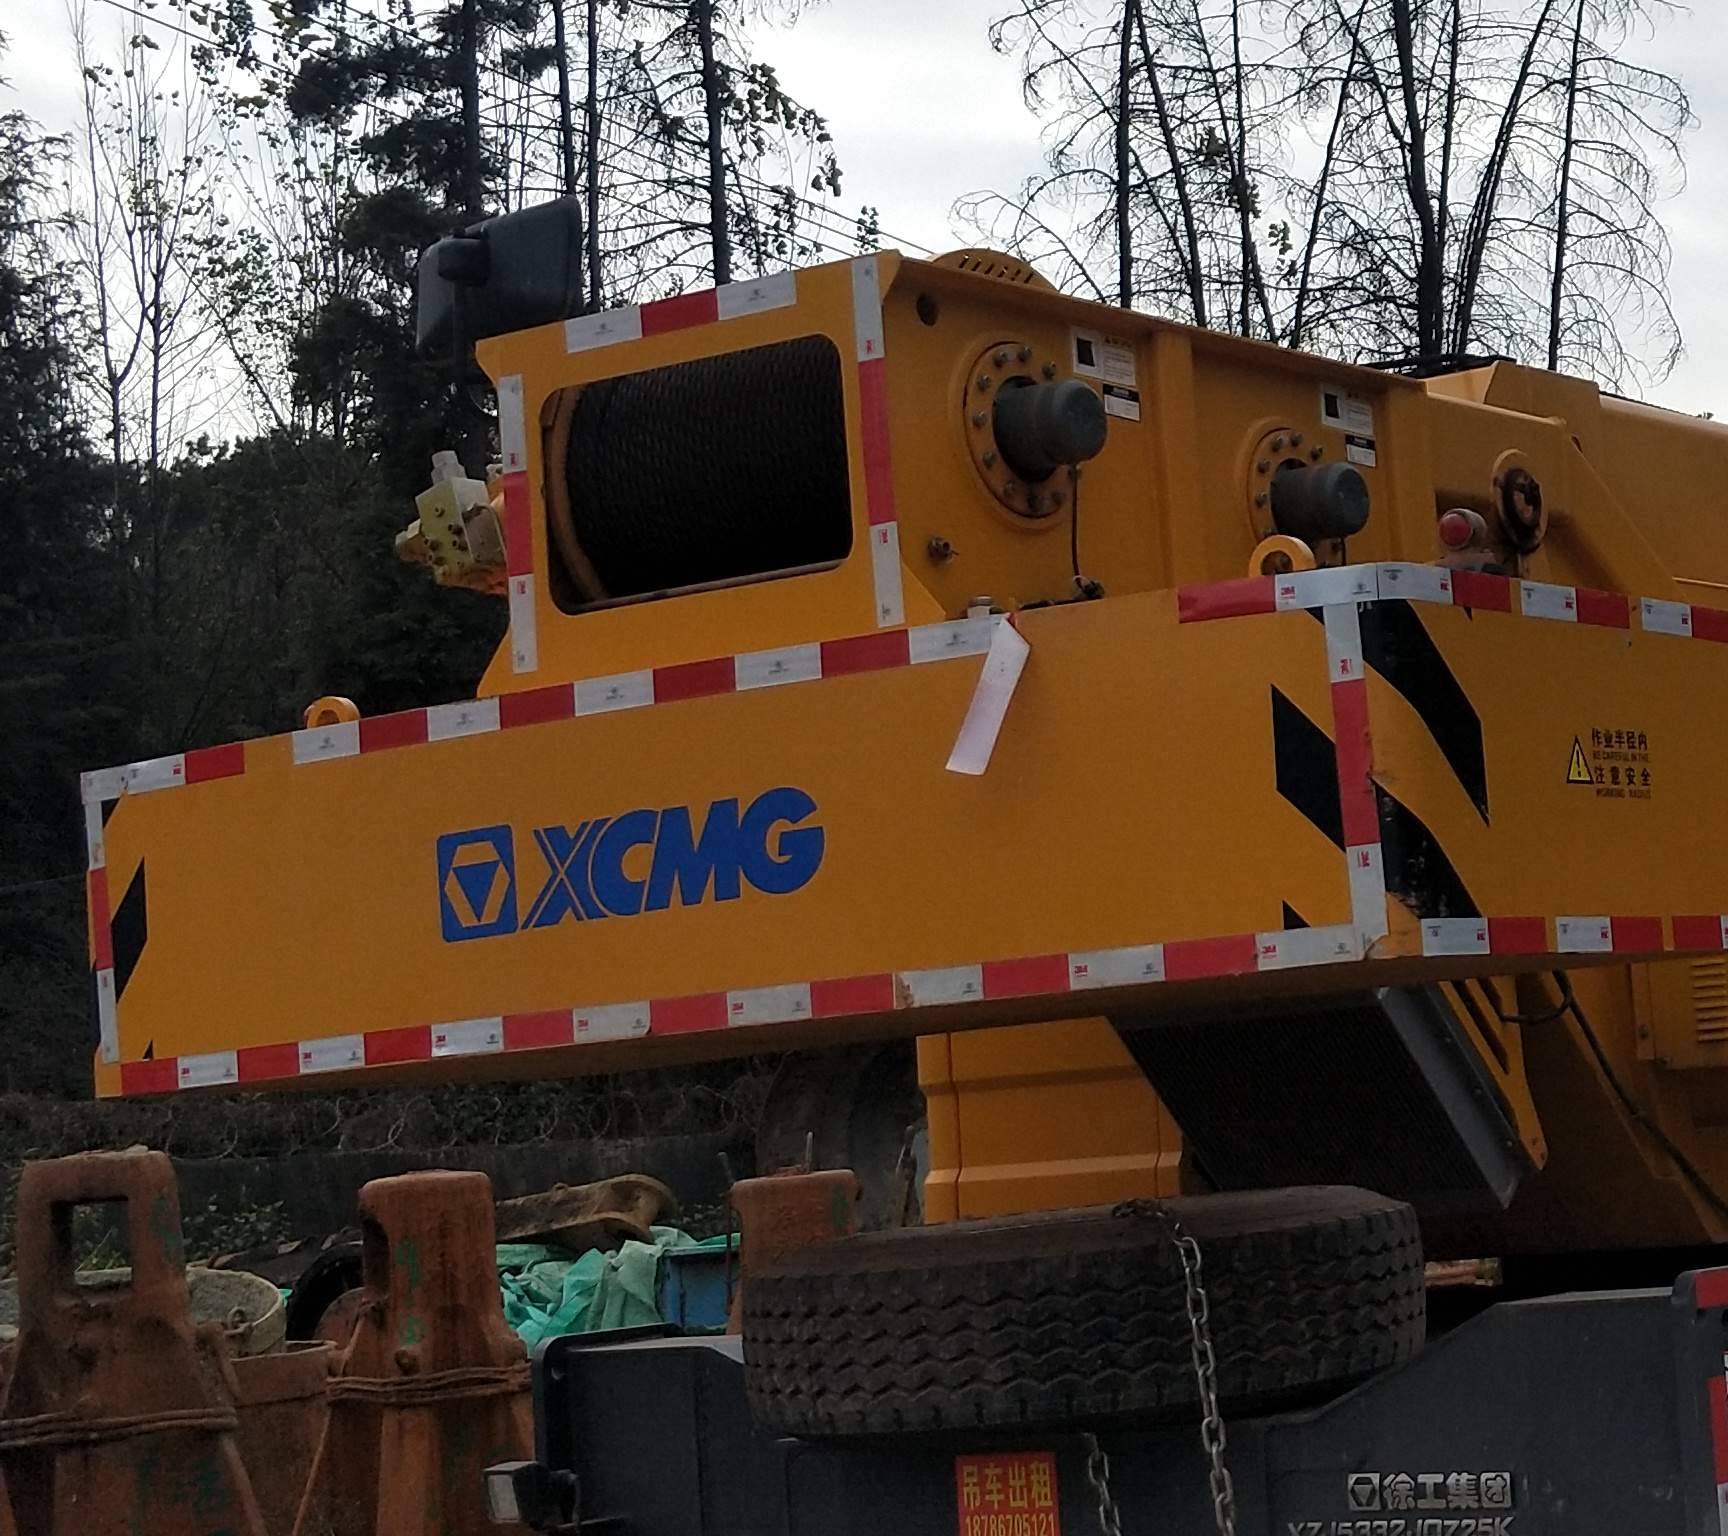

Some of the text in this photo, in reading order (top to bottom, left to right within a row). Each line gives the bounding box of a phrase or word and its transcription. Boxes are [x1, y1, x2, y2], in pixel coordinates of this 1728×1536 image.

[1591, 728, 1648, 752] 作业半径内
[1593, 765, 1652, 787] 注意安全
[522, 787, 825, 931] XCMG
[962, 1461, 1053, 1510] 吊车出租
[1382, 1471, 1512, 1511] 徐工集团
